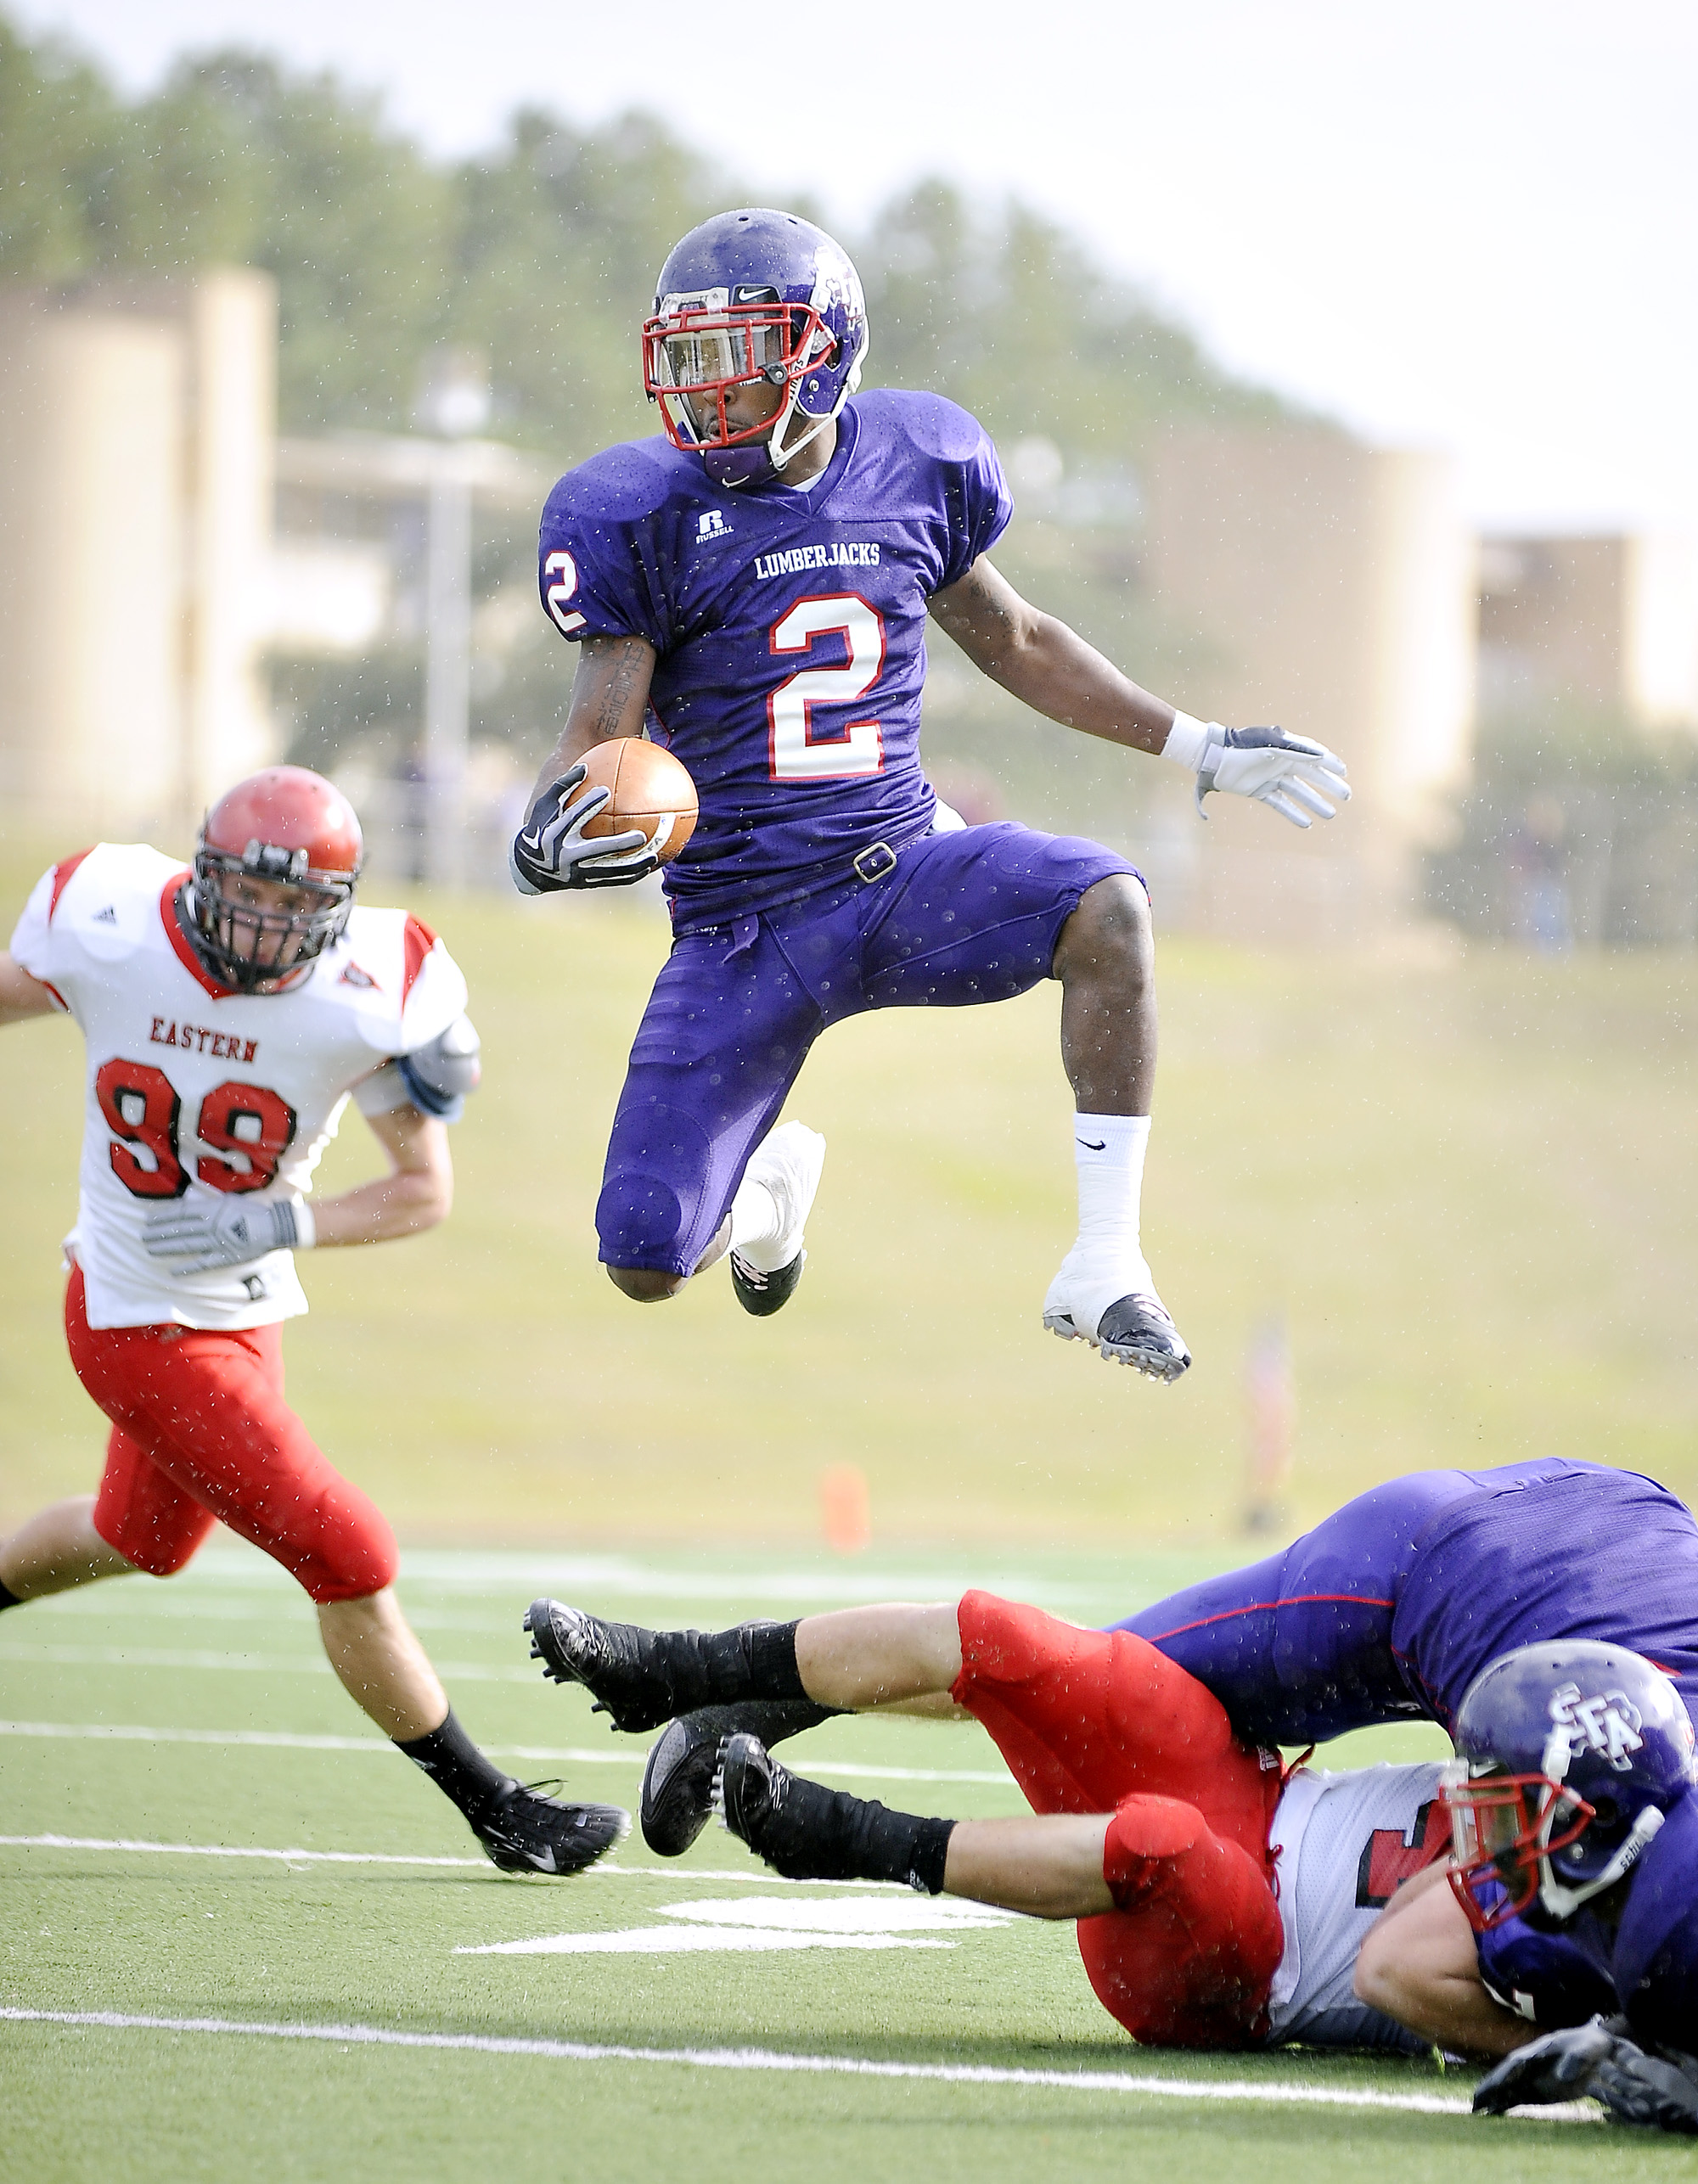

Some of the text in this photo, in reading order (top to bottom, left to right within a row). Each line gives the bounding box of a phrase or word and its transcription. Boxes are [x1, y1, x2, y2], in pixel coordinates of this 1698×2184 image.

[695, 525, 735, 544] RUSSELL
[754, 542, 880, 580] LUMBERJACKS
[544, 549, 588, 633] 2
[767, 591, 887, 782] 2
[150, 1016, 258, 1063] EASTERN
[96, 1058, 297, 1199] 99
